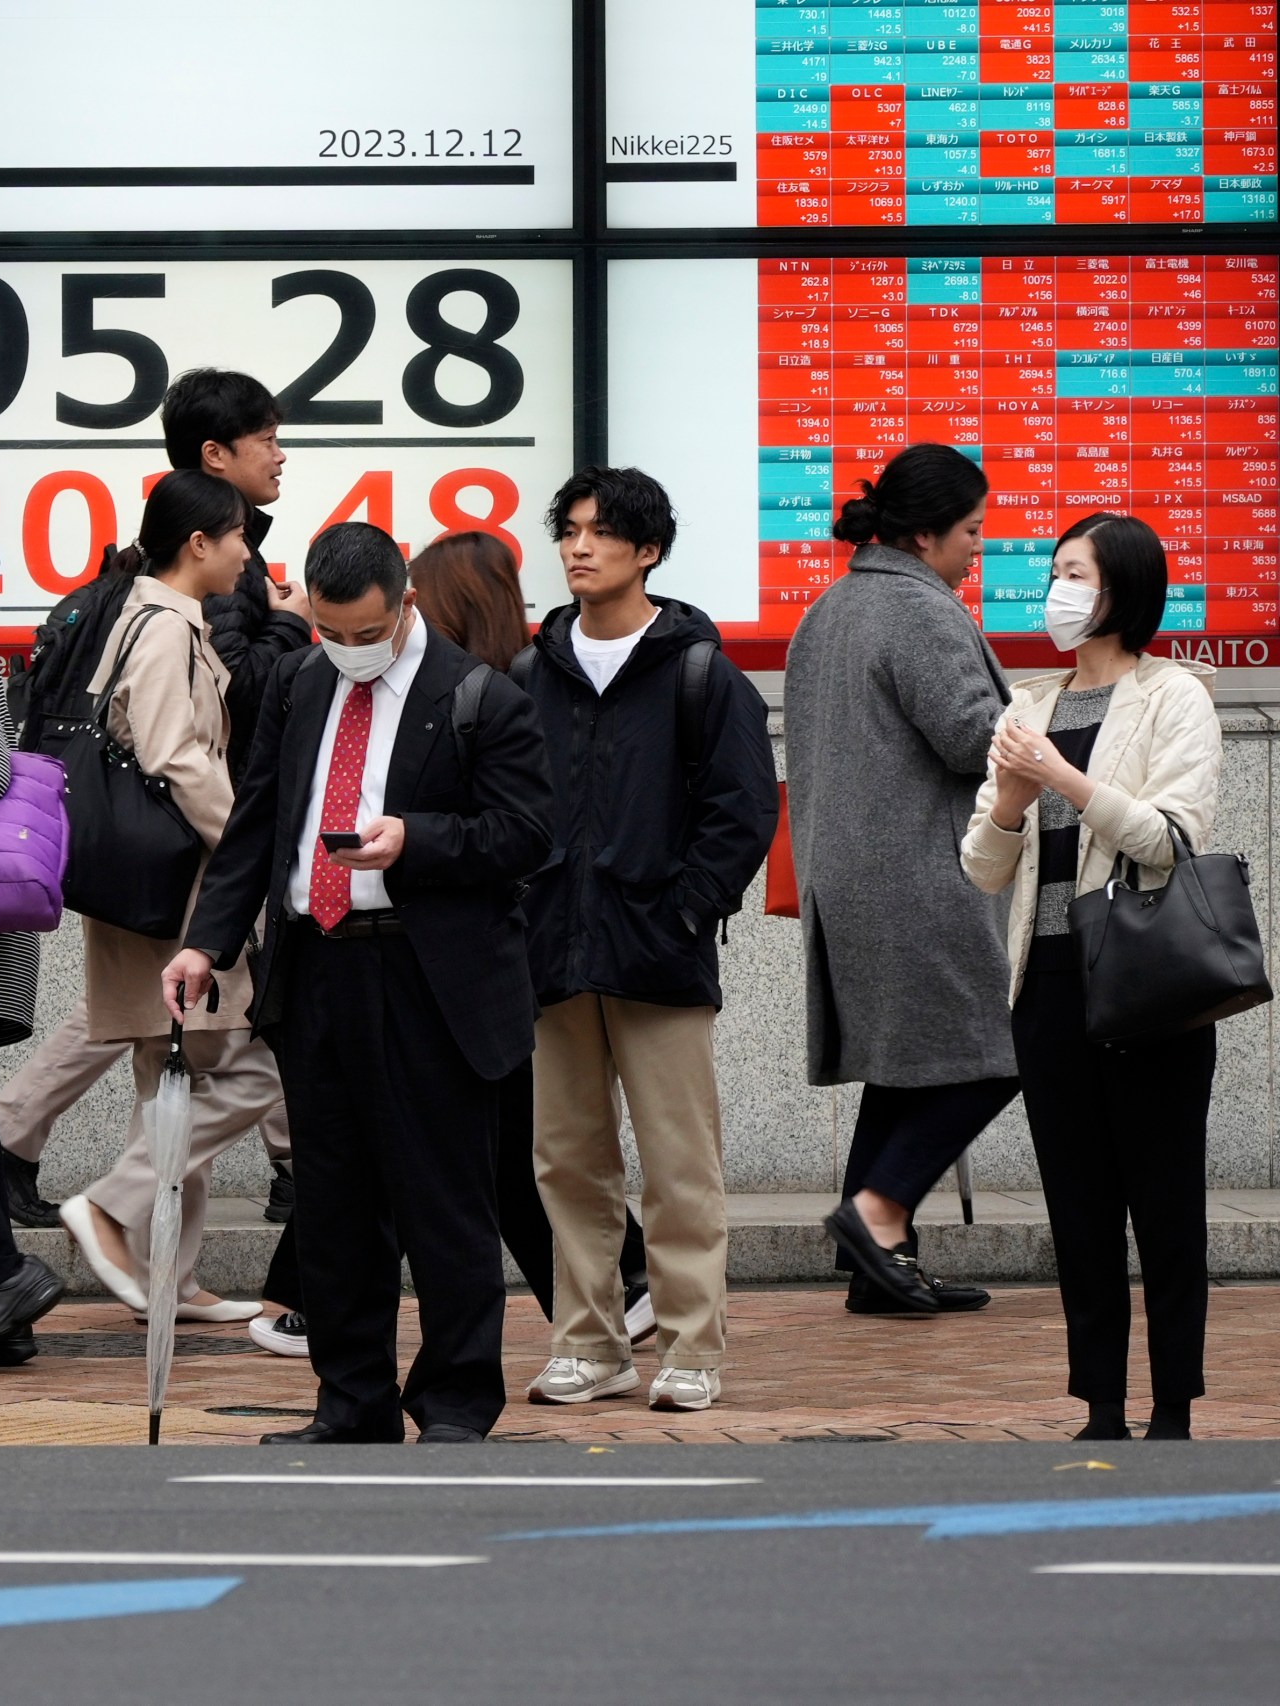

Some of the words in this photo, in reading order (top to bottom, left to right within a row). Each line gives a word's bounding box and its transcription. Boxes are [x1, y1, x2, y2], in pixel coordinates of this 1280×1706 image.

[869, 9, 901, 18] 1448.5
[943, 8, 976, 18] 1012.0
[1017, 8, 1050, 17] 2092.0
[1101, 7, 1125, 16] 3018
[1172, 7, 1199, 16] 532.5
[1250, 6, 1273, 15] 1337
[876, 24, 901, 34] -12.5
[771, 40, 814, 52] 三井化学
[927, 41, 956, 50] UBE
[1000, 39, 1031, 49] 電通G
[1070, 38, 1111, 49] メルカリ
[802, 57, 825, 66] 4171
[943, 56, 976, 65] 2248.5
[1027, 55, 1050, 64] 3823
[1092, 54, 1125, 64] 2634.5
[1175, 54, 1199, 63] 5865
[1249, 53, 1273, 62] 4119
[1100, 70, 1125, 79] -44.0
[778, 89, 807, 98] DIC
[852, 88, 882, 97] OLC
[1149, 85, 1180, 95] 楽天G
[794, 104, 827, 113] 2449.0
[878, 103, 901, 112] 5307
[1250, 100, 1274, 109] 8855
[997, 134, 1037, 143] TOTO
[1075, 133, 1107, 143] ガイシ
[1145, 132, 1187, 142] 日本製鉄
[1224, 131, 1256, 141] 神戸鋼
[318, 129, 522, 157] 2023.12.12
[611, 135, 733, 156] Nikkei225
[803, 151, 827, 160] 3579
[869, 151, 902, 160] 2730.0
[944, 150, 976, 159] 1057.5
[1027, 149, 1050, 158] 3677
[1093, 148, 1125, 158] 1681.5
[1176, 148, 1200, 157] 3327
[1242, 147, 1274, 156] 1673.0
[875, 166, 902, 175] +13.0
[848, 182, 889, 192] フジクラ
[1071, 180, 1113, 190] オークマ
[1151, 179, 1182, 189] アマダ
[1220, 178, 1261, 188] 日本郵政
[777, 183, 810, 193] 住友電
[795, 198, 827, 207] 1836.0
[870, 198, 902, 206] 1069.0
[945, 197, 976, 206] 1240.0
[1102, 195, 1125, 204] 5917
[1168, 195, 1200, 204] 1479.5
[1173, 210, 1200, 219] +17.0
[780, 262, 809, 271] NTN
[1077, 259, 1109, 269] 三菱電
[1146, 258, 1189, 268] 富士電機
[1226, 258, 1258, 268] 安川電
[871, 277, 903, 285] 1287.0
[945, 276, 978, 285] 2698.5
[1023, 275, 1052, 284] 10075
[1094, 275, 1127, 284] 2022.0
[1177, 274, 1201, 283] 5984
[1252, 274, 1275, 283] 5342
[848, 308, 889, 318] ソニーG
[929, 308, 958, 317] TDK
[1076, 306, 1109, 316] 横河電
[874, 324, 903, 332] 13065
[953, 323, 978, 332] 6729
[1020, 322, 1052, 332] 1246.5
[1094, 322, 1127, 331] 2740.0
[1177, 322, 1201, 330] 4399
[1245, 321, 1275, 330] 61070
[802, 339, 829, 348] +18.9
[779, 355, 811, 365] 日立造
[854, 355, 885, 365] 三菱重
[1006, 354, 1031, 363] IHI
[1152, 352, 1183, 363] 日産自
[880, 371, 903, 380] 7954
[954, 370, 978, 379] 3130
[1019, 370, 1052, 379] 2694.5
[779, 403, 811, 412] ニコン
[999, 402, 1038, 410] HOYA
[1153, 400, 1183, 409] リコー
[797, 418, 829, 427] 1394.0
[870, 418, 904, 427] 2126.5
[949, 417, 978, 426] 11395
[1023, 417, 1052, 426] 16970
[1103, 416, 1127, 425] 3818
[1169, 415, 1201, 424] 1136.5
[877, 433, 904, 442] +14.0
[780, 450, 811, 460] 三井物
[1004, 447, 1034, 458] 三菱商
[1077, 447, 1109, 457] 高島屋
[1152, 447, 1182, 457] 丸井G
[805, 465, 829, 474] 5236
[1028, 464, 1052, 473] 6839
[1094, 463, 1127, 472] 2048.5
[1168, 462, 1201, 472] 2344.5
[1243, 462, 1276, 471] 2590.5
[1174, 478, 1201, 487] +15.5
[779, 496, 811, 507] みずほ
[997, 495, 1039, 505] 野村HD
[1066, 495, 1121, 504] SOMPOHD
[1154, 494, 1182, 503] JPX
[1223, 494, 1261, 503] MS&AD
[796, 512, 829, 522] 2490.0
[1025, 511, 1052, 520] 612.5
[1169, 509, 1201, 519] 2929.5
[1252, 509, 1276, 518] 5688
[1224, 540, 1263, 550] JR東海
[797, 560, 829, 568] 1748.5
[1178, 556, 1201, 565] 5943
[1253, 556, 1276, 565] 3639
[781, 590, 810, 601] NTT
[1226, 587, 1258, 597] 東ガス
[1169, 602, 1202, 614] 2066.5
[1252, 603, 1276, 612] 3573
[1177, 617, 1202, 629] -11.0
[1171, 640, 1269, 665] NAITO
